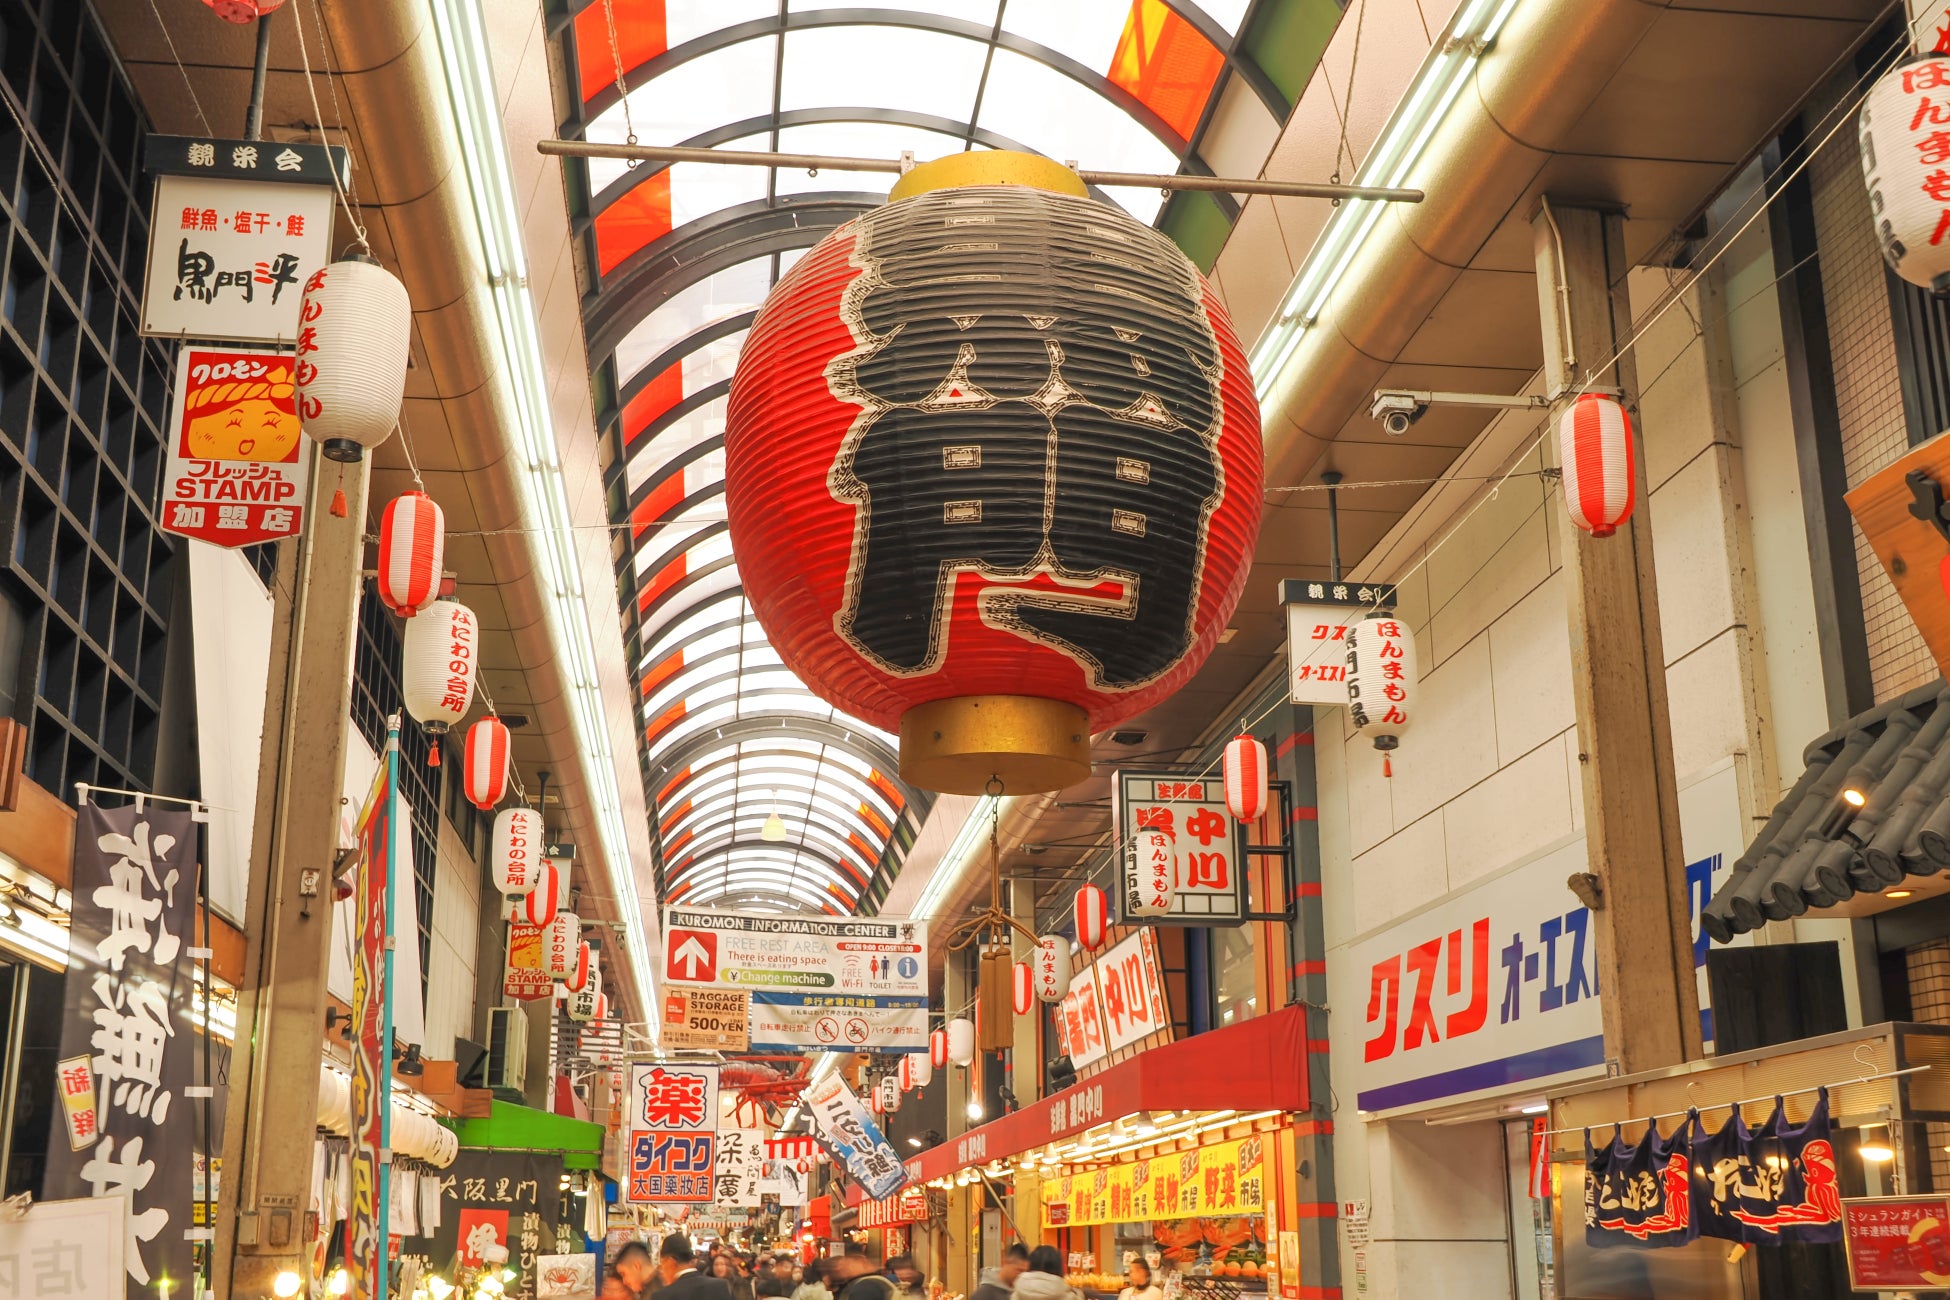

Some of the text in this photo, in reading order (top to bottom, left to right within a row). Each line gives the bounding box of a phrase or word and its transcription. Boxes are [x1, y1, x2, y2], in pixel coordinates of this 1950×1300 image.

[181, 207, 305, 237] 鮮魚・塩干・鮭
[296, 267, 329, 424] ほんまもん
[191, 363, 268, 385] クロモン
[187, 461, 283, 481] フレッシュ
[175, 479, 296, 502] STAMP
[172, 503, 293, 532] 加盟店
[440, 608, 472, 713] なにわの台所
[1376, 621, 1407, 725] ほんまもん
[506, 812, 528, 886] なにわの台所
[1150, 834, 1168, 908] ほんまもん
[677, 914, 889, 937] KUROMON INFORMATION CENTER
[551, 916, 567, 973] なにわの台所
[726, 936, 830, 954] FREE REST AREA
[728, 950, 827, 966] There is eating space
[845, 943, 862, 951] OPEN
[741, 971, 780, 985] Change
[782, 975, 826, 986] machine
[842, 968, 862, 978] FREE
[1042, 940, 1057, 997] ほんまもん
[1500, 906, 1601, 1025] オーエス
[508, 975, 551, 984] STAMP
[842, 979, 863, 988] Wi-Fi
[1364, 917, 1490, 1063] クスリ
[691, 991, 745, 1003] BAGGAGE
[691, 1001, 745, 1012] STORAGE
[690, 1017, 744, 1032] 500 YEN
[646, 1068, 705, 1127] 薬
[635, 1134, 711, 1172] ダイコク
[1154, 1173, 1179, 1215] 果物
[1181, 1186, 1198, 1212] 市場
[1204, 1162, 1236, 1210] 野菜
[1240, 1178, 1260, 1207] 市場
[1111, 1181, 1132, 1219] 精肉
[1849, 1208, 1933, 1223] ミシュランガイド
[1850, 1225, 1911, 1237] 3年連続掲載
